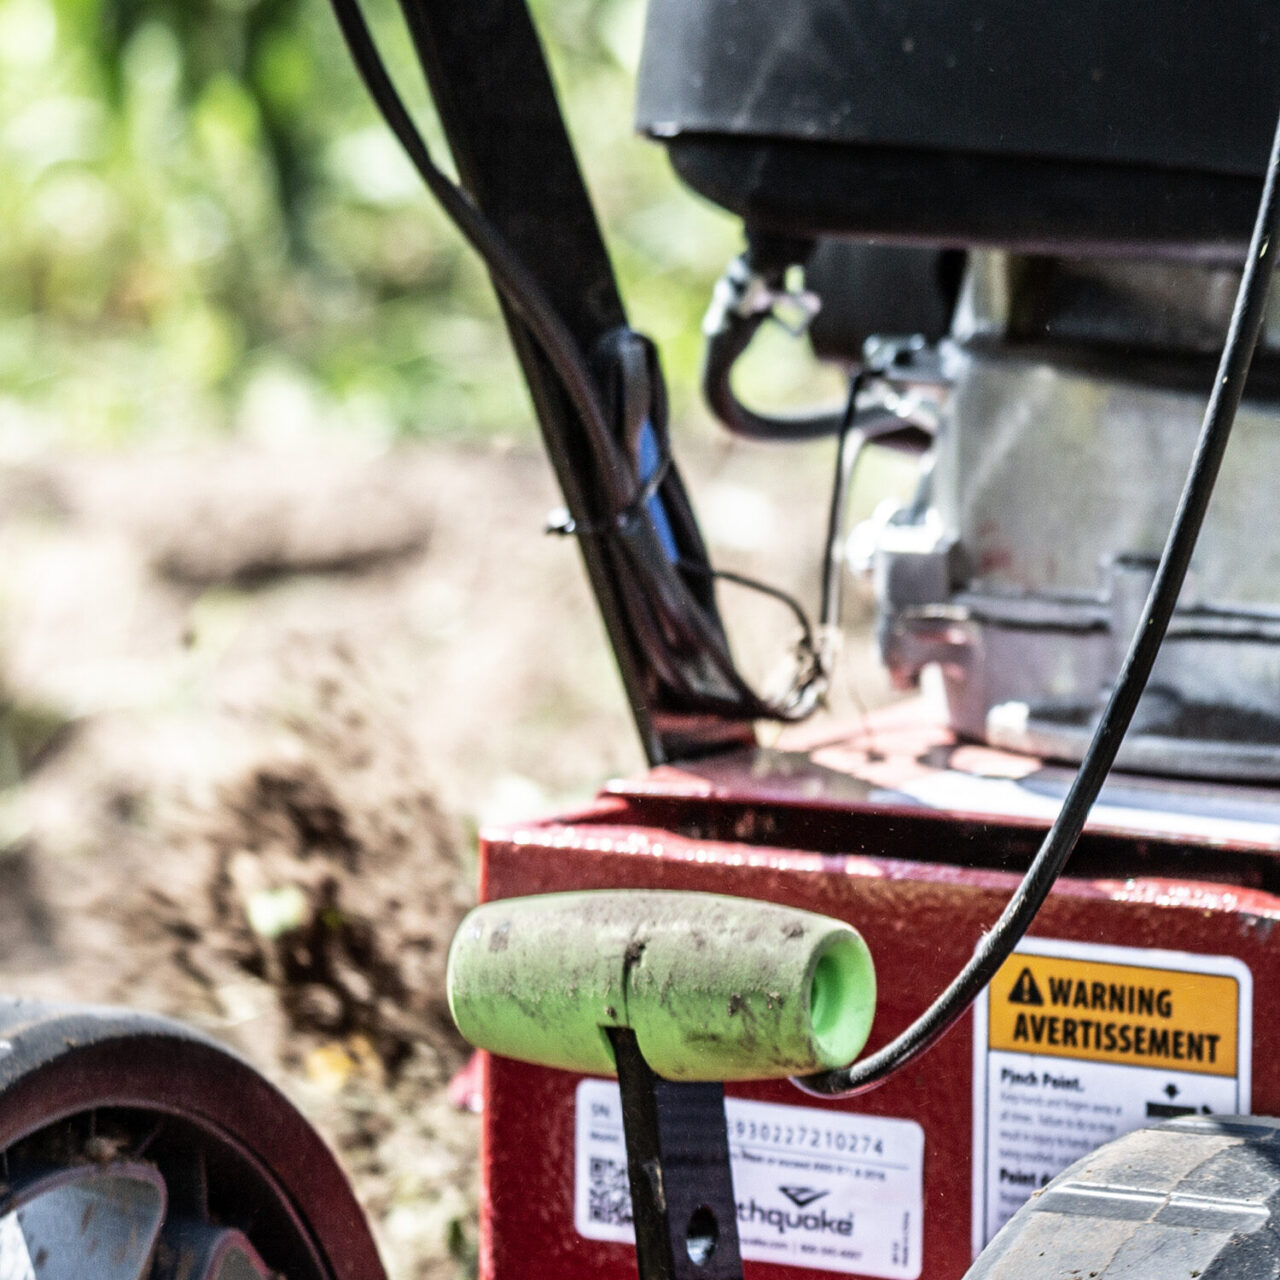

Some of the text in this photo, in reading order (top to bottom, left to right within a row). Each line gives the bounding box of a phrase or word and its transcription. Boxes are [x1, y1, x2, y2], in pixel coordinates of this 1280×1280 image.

[1048, 977, 1173, 1018] WARNING
[1013, 1013, 1221, 1064] AVERTISSEMENT
[728, 1119, 884, 1155] 930227210274
[736, 1199, 853, 1237] thquake
